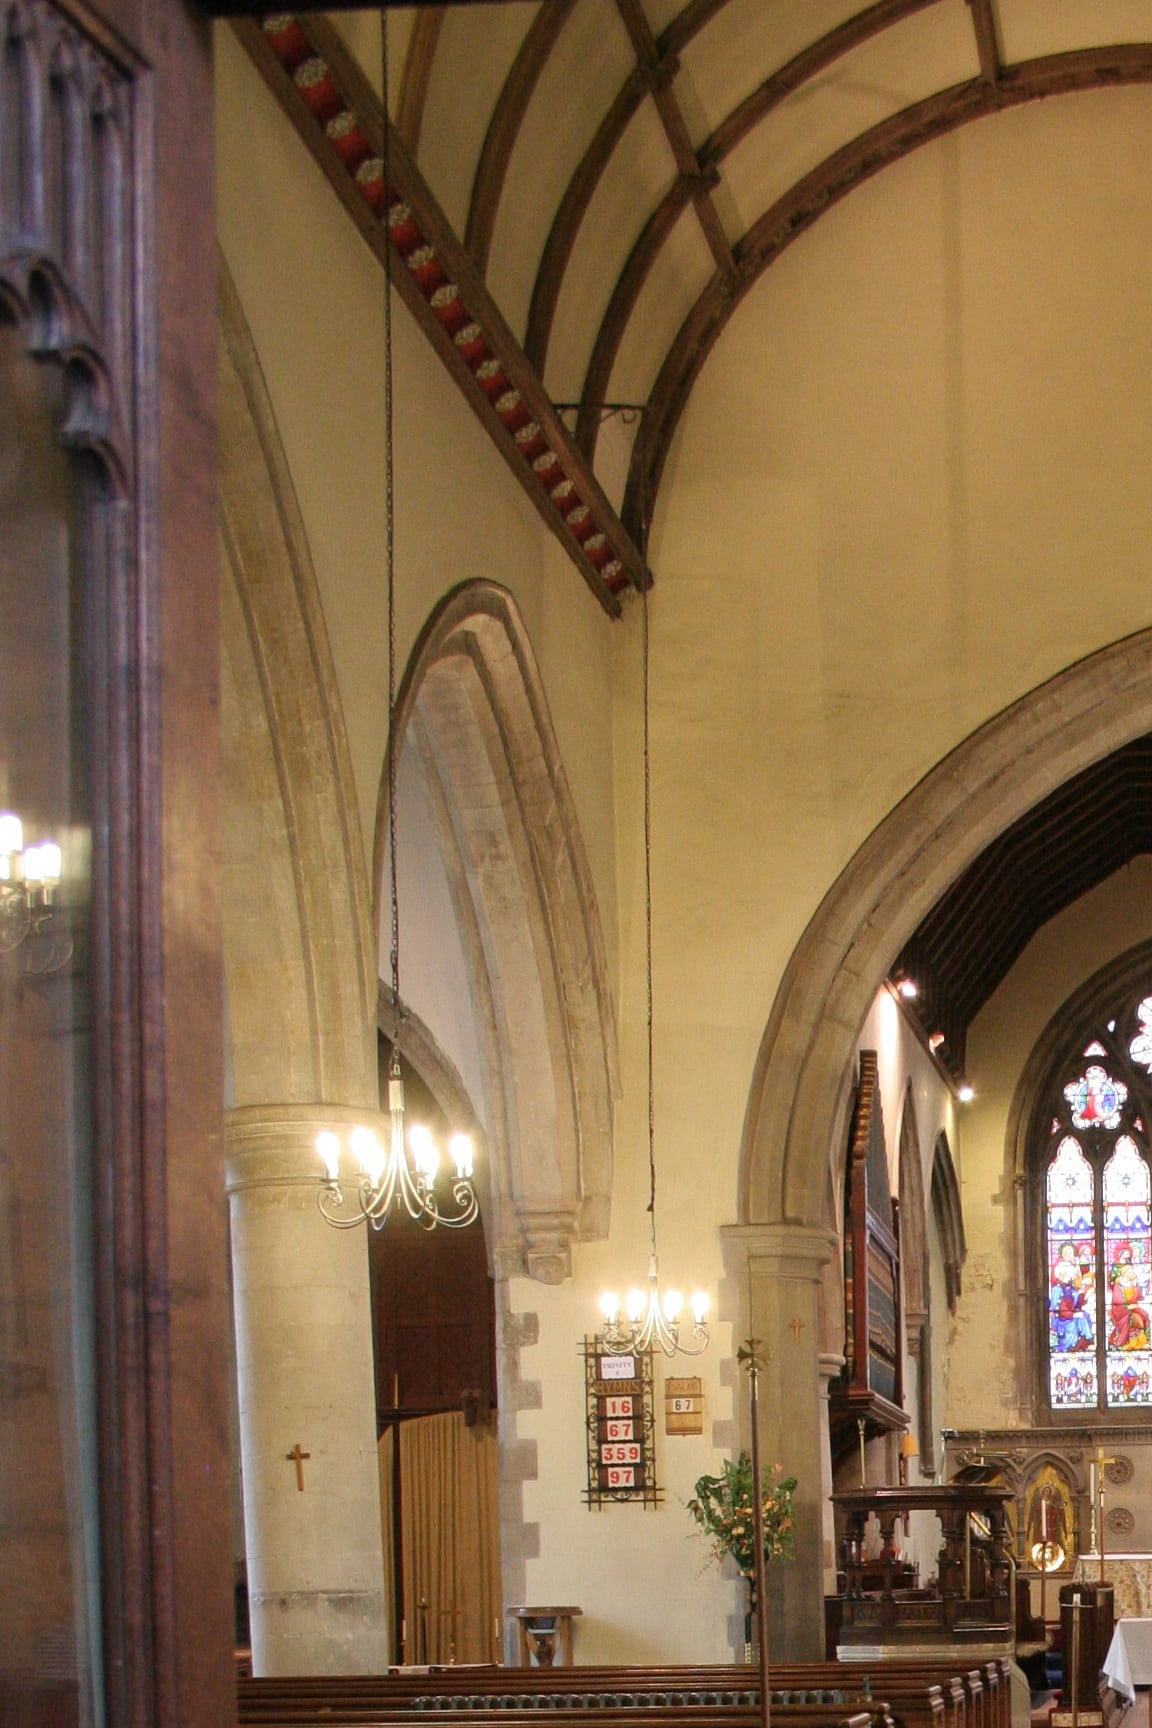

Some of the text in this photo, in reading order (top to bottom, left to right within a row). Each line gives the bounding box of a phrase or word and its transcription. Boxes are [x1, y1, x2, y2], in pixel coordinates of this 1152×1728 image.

[597, 1381, 640, 1394] HYMNS
[610, 1400, 631, 1414] 16
[674, 1400, 691, 1411] 67
[609, 1424, 631, 1437] 67
[604, 1447, 639, 1461] 359
[610, 1470, 632, 1484] 97
